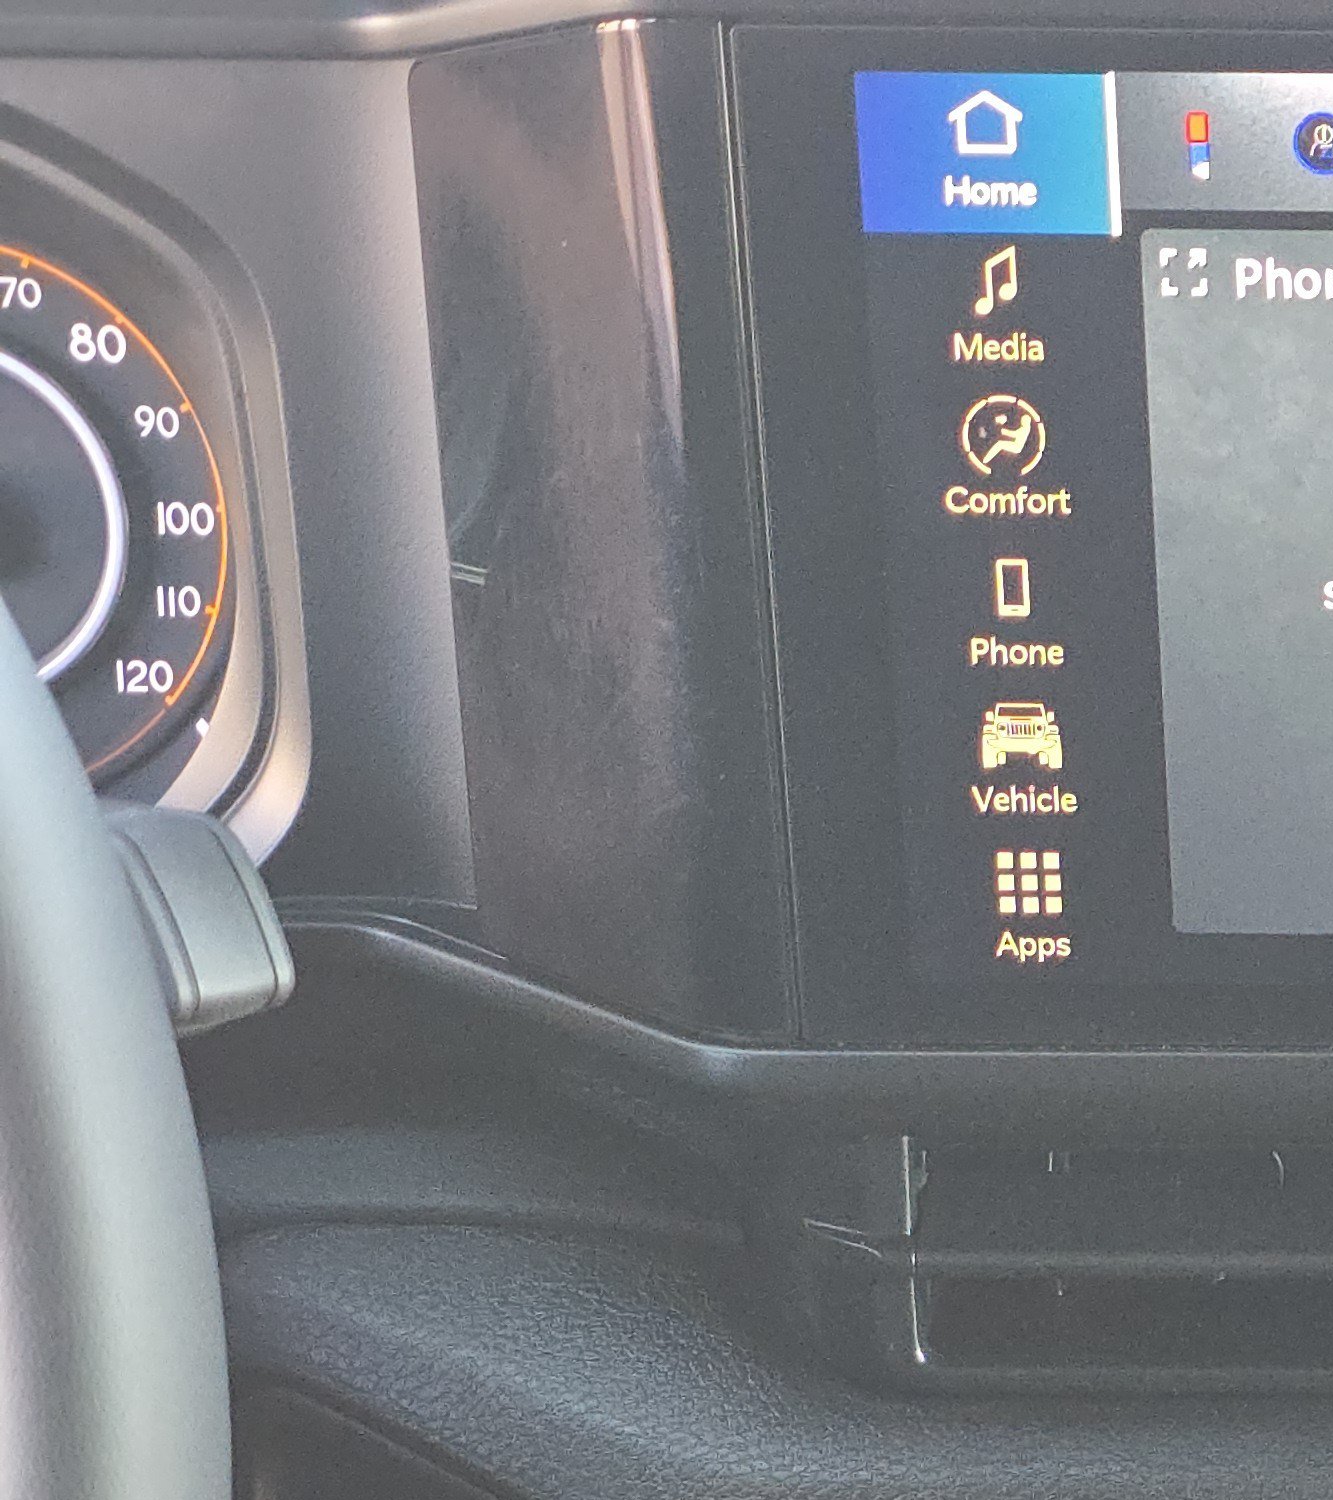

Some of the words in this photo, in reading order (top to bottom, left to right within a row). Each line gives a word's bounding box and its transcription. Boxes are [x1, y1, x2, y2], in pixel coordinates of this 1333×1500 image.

[942, 174, 1038, 208] Home
[0, 276, 43, 310] 70
[68, 322, 128, 365] 80
[952, 332, 1046, 364] Media
[133, 404, 181, 440] 90
[944, 484, 1072, 516] Comfort
[157, 501, 215, 537] 100
[156, 584, 202, 618] 110
[969, 637, 1066, 667] Phone
[115, 660, 174, 694] 120
[971, 784, 1079, 815] Vehicle
[995, 932, 1072, 962] Apps
